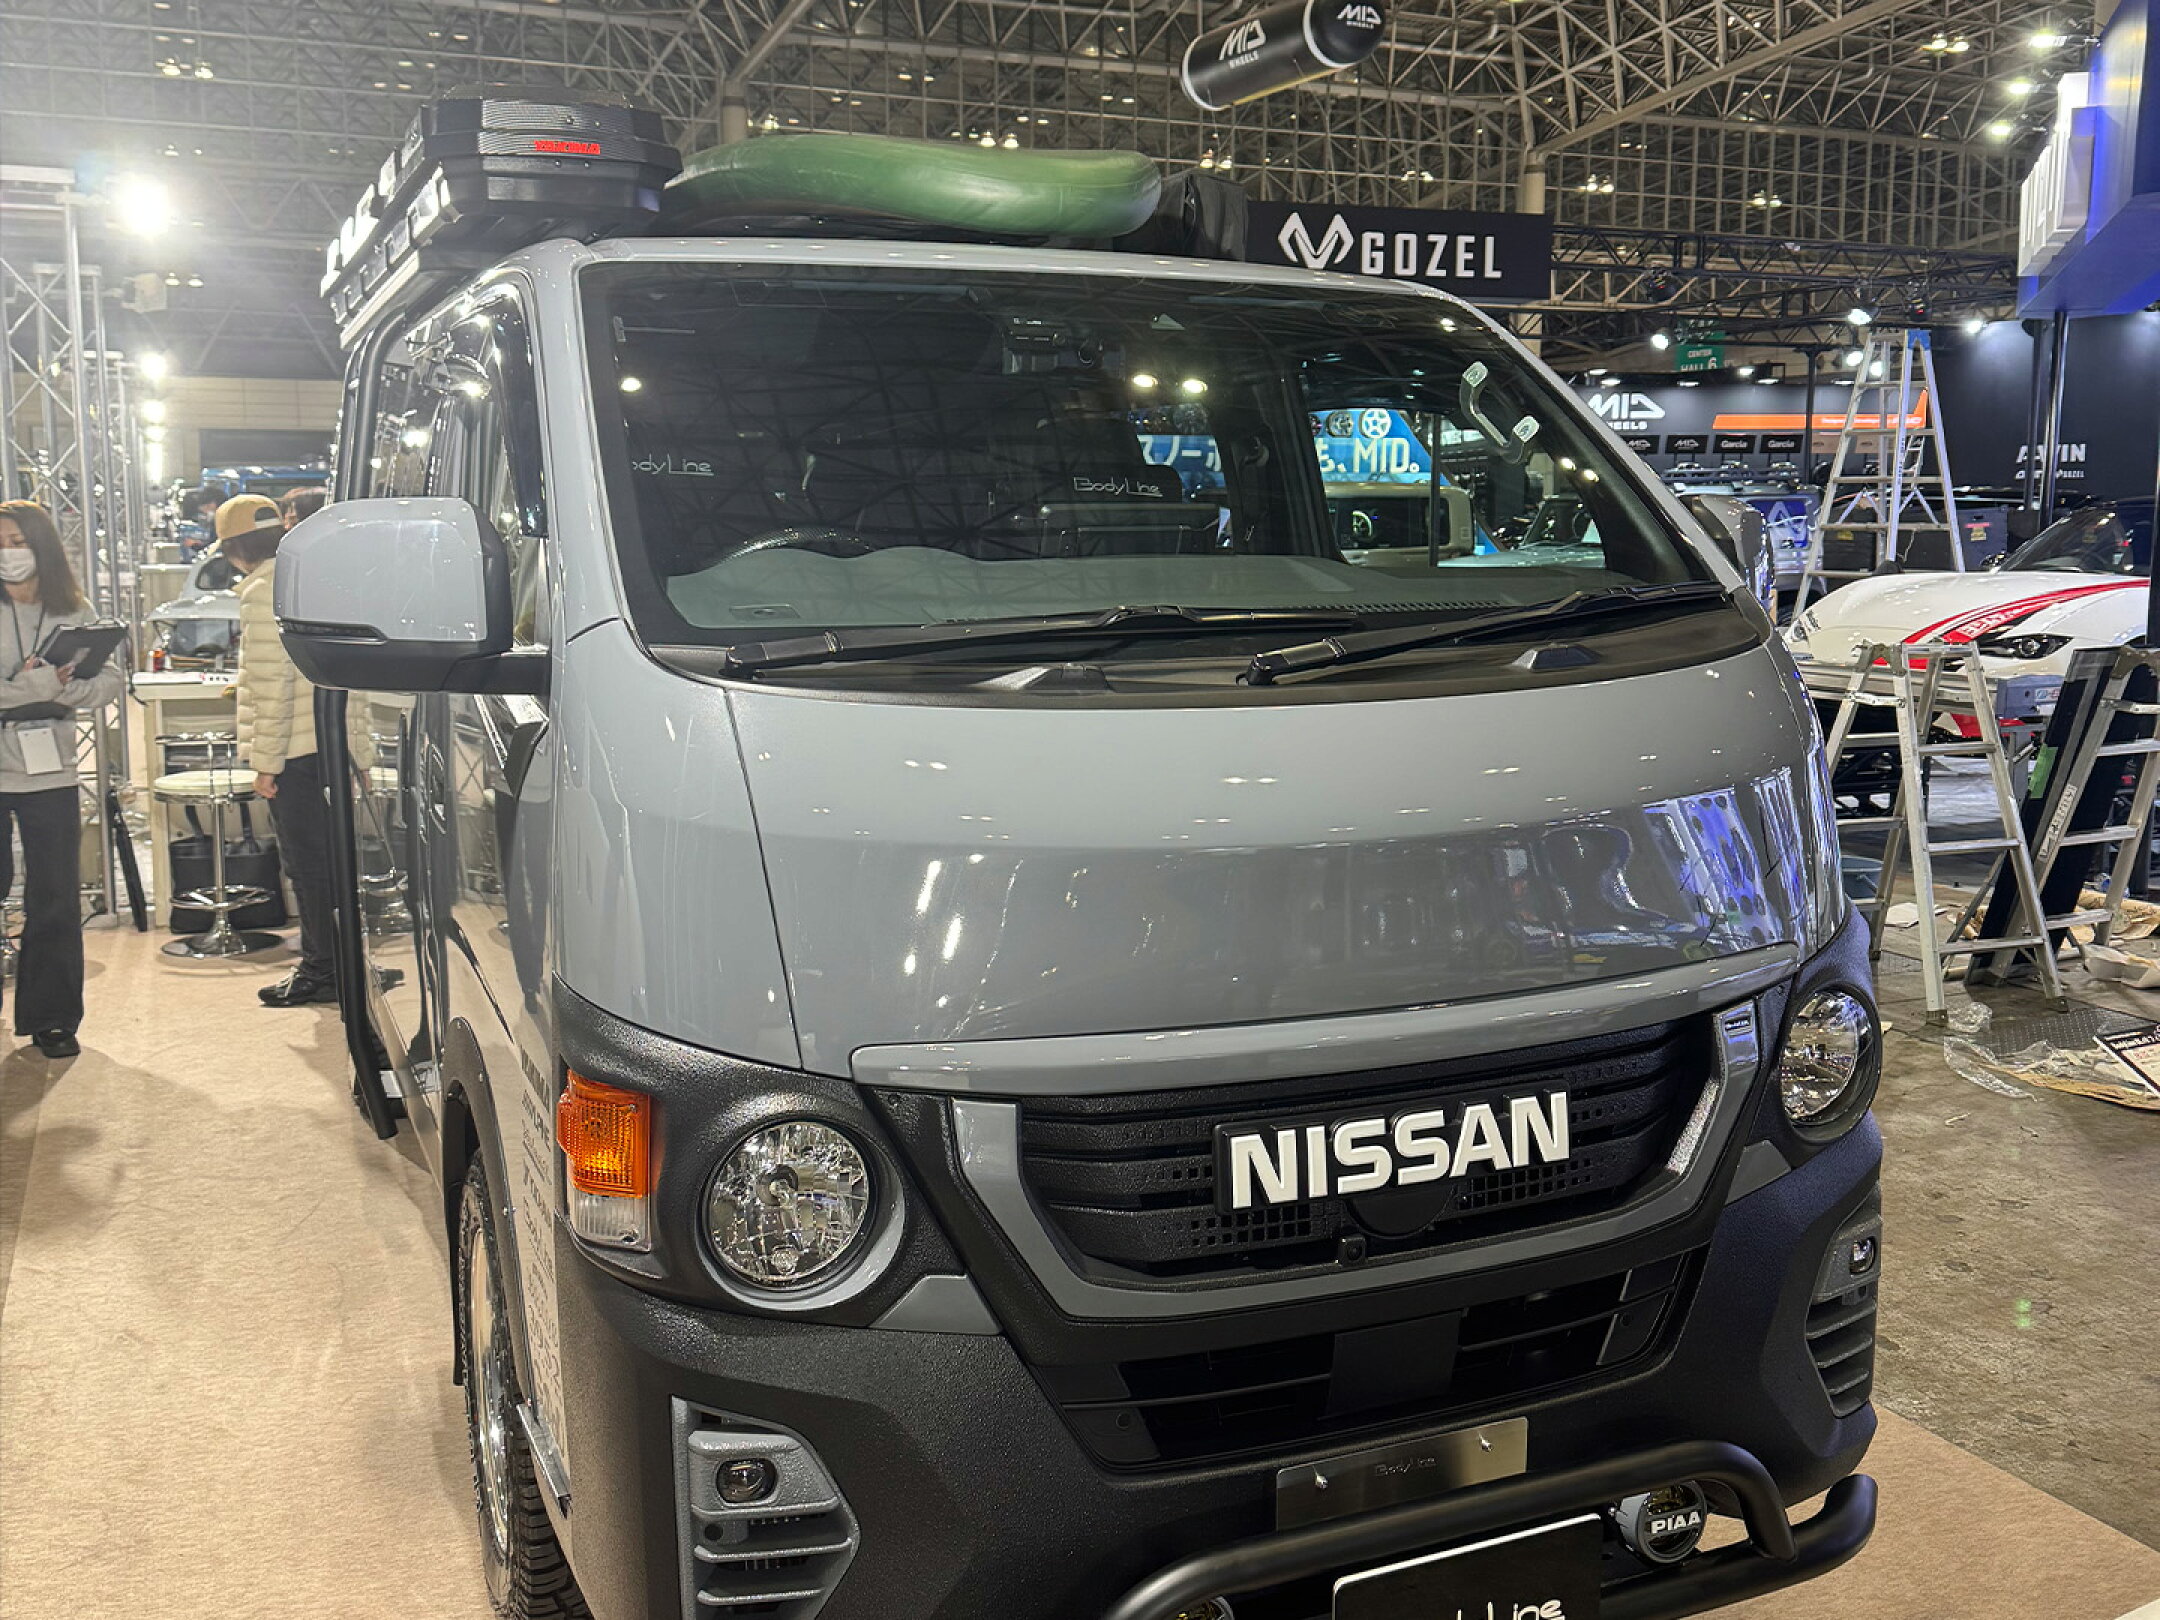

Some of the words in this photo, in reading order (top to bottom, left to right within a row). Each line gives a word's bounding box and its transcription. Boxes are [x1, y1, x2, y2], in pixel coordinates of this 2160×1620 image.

[1361, 231, 1502, 279] GOZEL
[1230, 1091, 1570, 1210] NISSAN
[1651, 1511, 1702, 1534] PIAA
